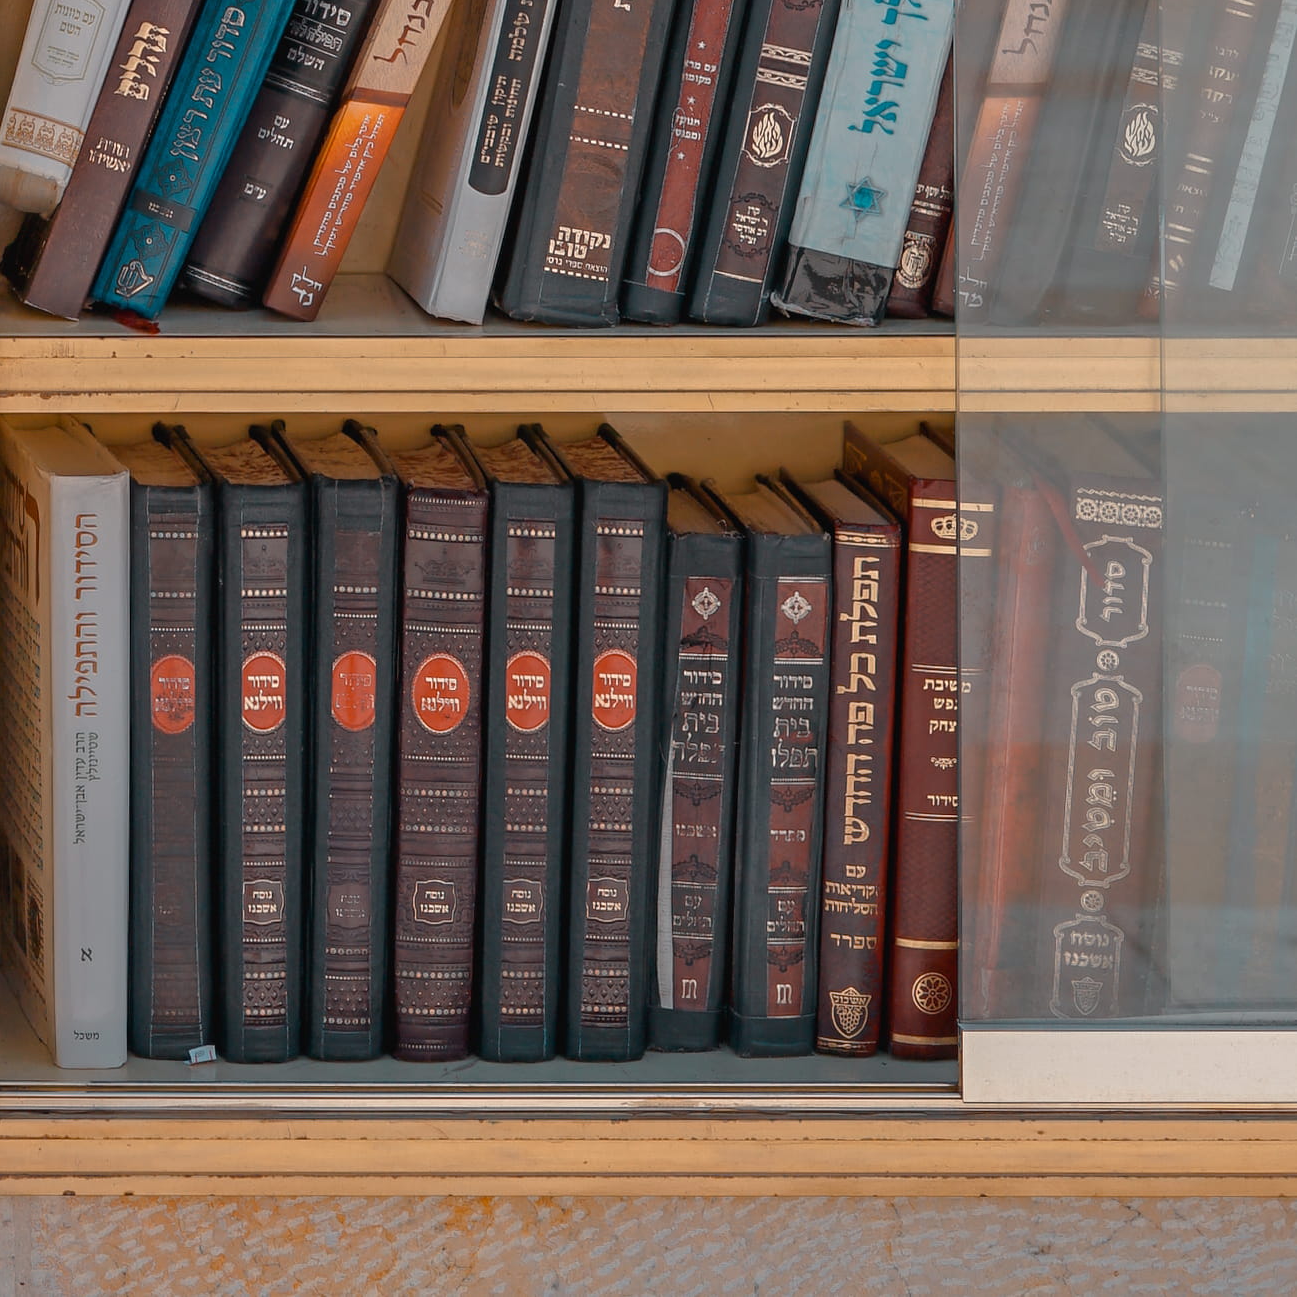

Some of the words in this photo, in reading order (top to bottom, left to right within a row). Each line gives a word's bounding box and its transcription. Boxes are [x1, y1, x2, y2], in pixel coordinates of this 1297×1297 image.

[59, 21, 81, 36] השם
[82, 12, 95, 25] עם
[508, 11, 531, 62] שלמה
[847, 38, 909, 136] ישראל
[558, 226, 611, 250] נקודה
[74, 513, 99, 600] הסידור
[839, 556, 880, 645] תפלת
[67, 611, 99, 718] והתפילה
[835, 652, 876, 696] כל
[247, 675, 281, 693] סידור
[511, 674, 545, 689] סידור
[598, 673, 632, 688] סידור
[244, 692, 284, 714] ווילנא
[508, 689, 548, 710] ווילנא
[594, 689, 634, 710] ווילנא
[846, 701, 875, 744] פה
[76, 731, 85, 752] הרב
[76, 757, 85, 780] עדין
[843, 751, 873, 845] החדש
[846, 864, 866, 879] עם
[247, 901, 277, 916] אשכנז
[506, 901, 536, 915] אשכנז
[830, 931, 877, 949] ספרד
[81, 945, 94, 962] א
[73, 1028, 100, 1041] משכל
